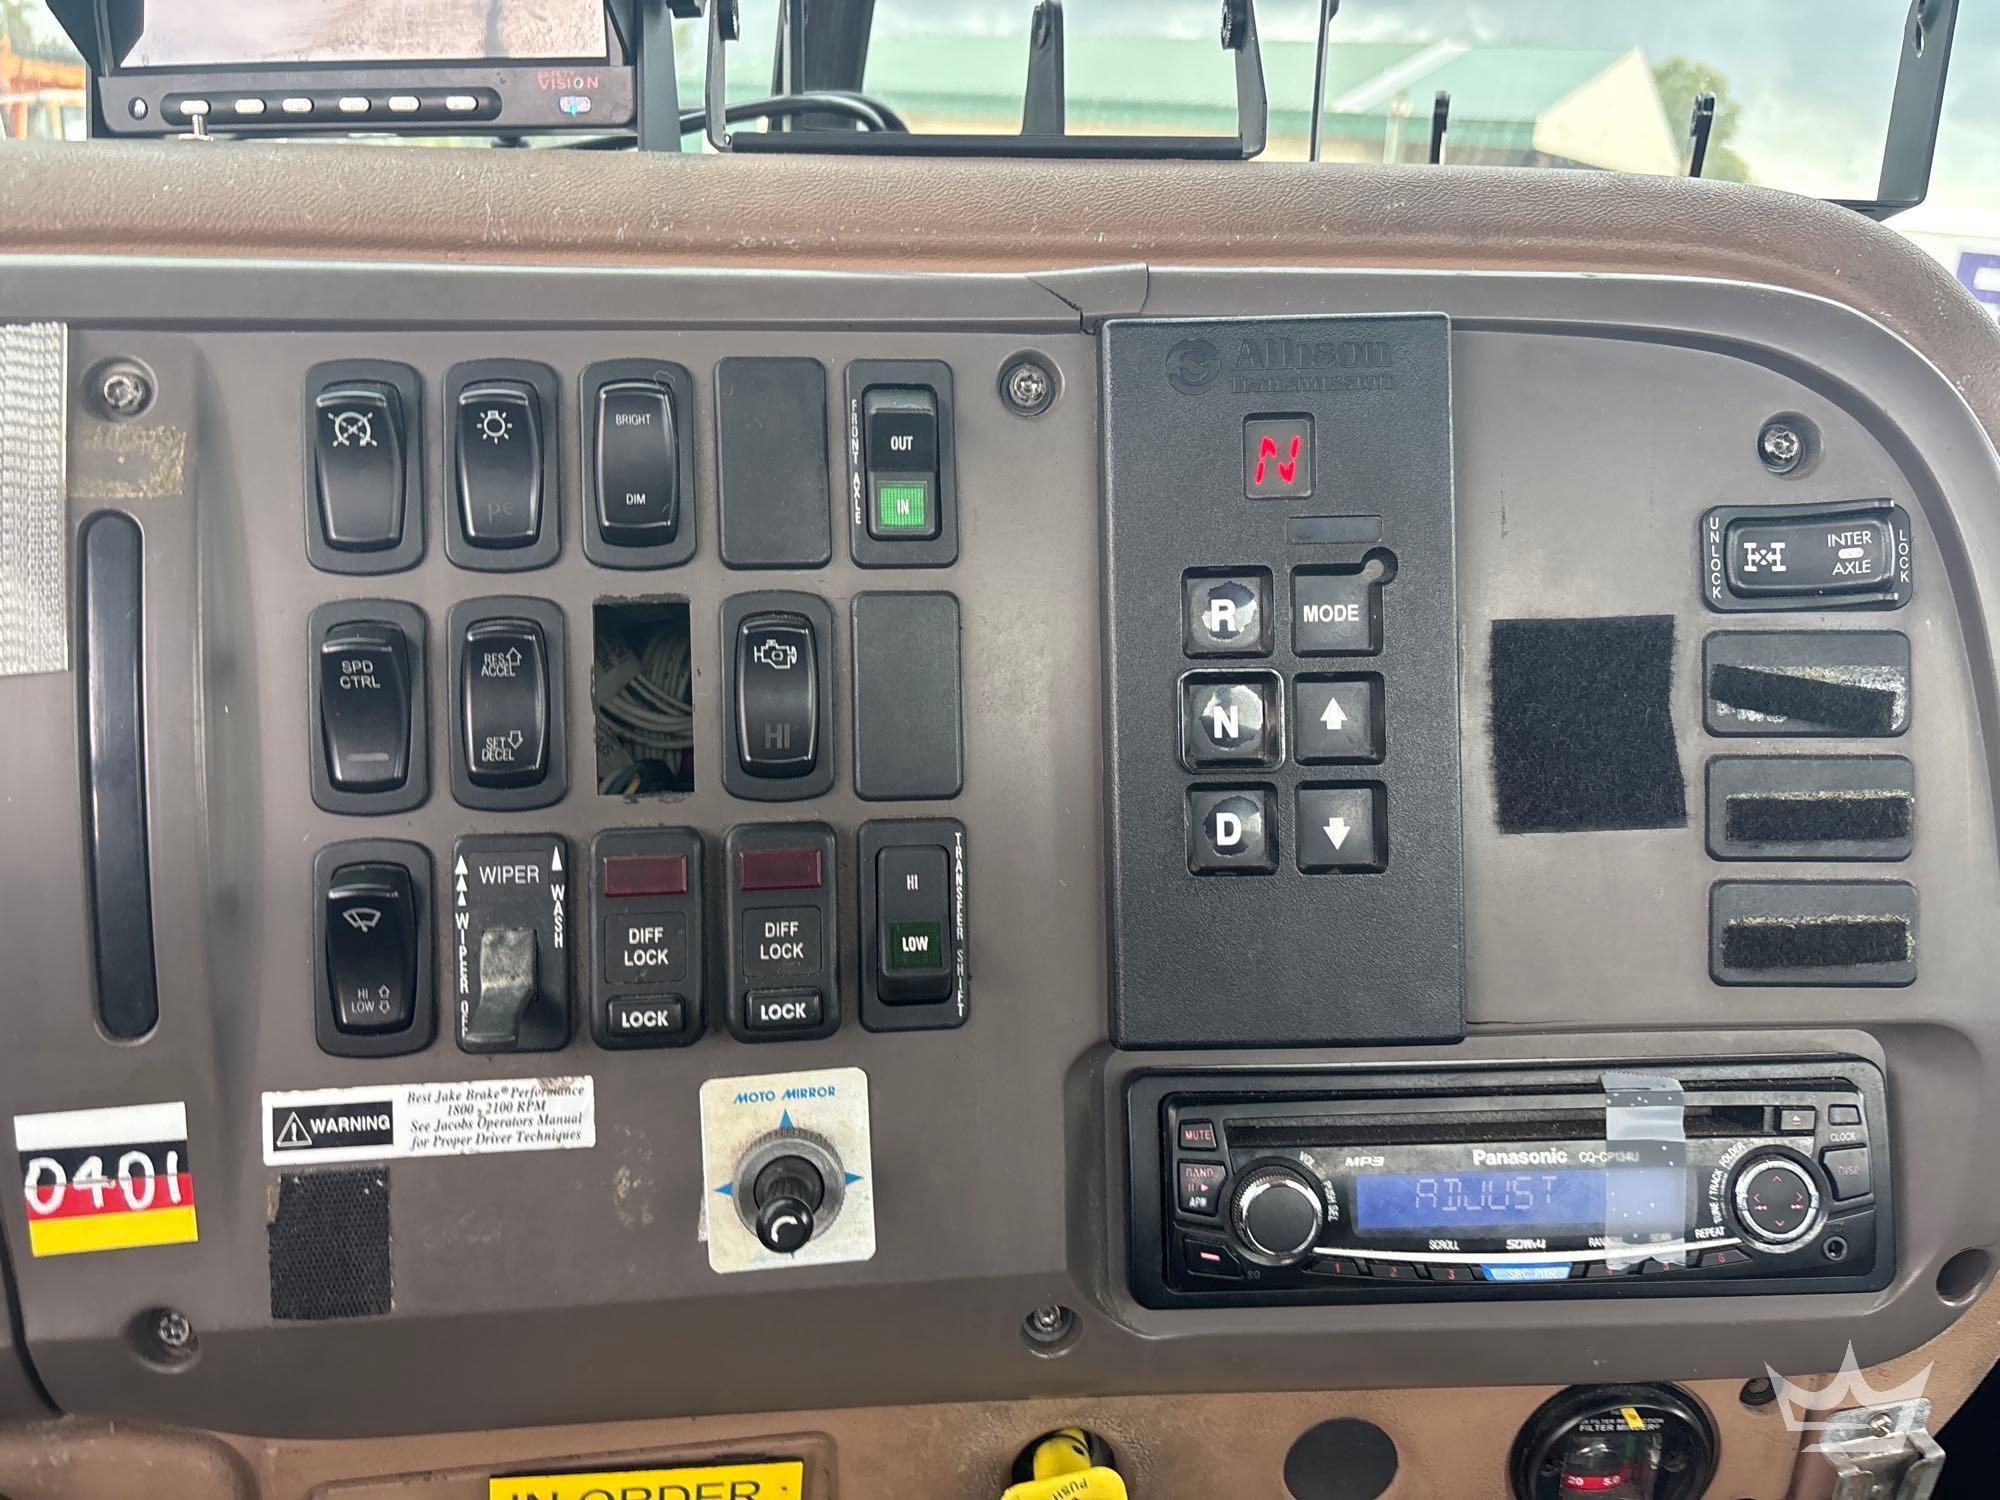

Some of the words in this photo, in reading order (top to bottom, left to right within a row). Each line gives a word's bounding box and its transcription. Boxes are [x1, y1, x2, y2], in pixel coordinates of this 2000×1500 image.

[537, 76, 599, 91] VISION
[615, 413, 651, 426] BRIGHT
[851, 399, 860, 464] FRONT
[891, 436, 914, 451] OUT
[1255, 435, 1300, 485] N
[626, 494, 646, 505] DIM
[853, 472, 862, 525] AXLE
[896, 500, 910, 515] IN
[1827, 530, 1873, 548] INTER
[1709, 517, 1722, 599] UNLOCK
[1898, 529, 1909, 583] LOCK
[1832, 560, 1872, 576] AXLE
[1210, 598, 1237, 632] R
[1303, 604, 1360, 623] MODE
[342, 661, 373, 674] SPD
[481, 664, 517, 678] ACCEL
[340, 676, 381, 690] CTRL
[1213, 706, 1239, 738] N
[486, 736, 507, 750] SET
[765, 723, 791, 749] HI
[481, 748, 515, 762] DECEL
[1215, 812, 1242, 846] D
[479, 865, 540, 885] WIPER
[906, 874, 919, 890] HI
[954, 832, 964, 941] TRANSFER
[550, 884, 566, 949] WASH
[628, 927, 664, 944] DIFF
[764, 921, 799, 938] DIFF
[759, 942, 804, 960] LOCK
[902, 935, 929, 952] LOW
[455, 912, 470, 994] WIPER
[623, 948, 670, 966] LOCK
[956, 949, 964, 1017] SHIFT
[357, 987, 369, 999] HI
[351, 1001, 375, 1014] LOW
[760, 1002, 807, 1021] LOCK
[621, 1010, 669, 1028] LOCK
[408, 1091, 431, 1104] Best
[434, 1090, 462, 1104] Jake
[733, 1090, 776, 1104] MOTO
[781, 1086, 836, 1100] MIRROR
[447, 1103, 474, 1116] 1800
[485, 1101, 513, 1115] 2100
[517, 1099, 546, 1113] RPM
[310, 1115, 390, 1134] WARNING
[410, 1119, 431, 1133] See
[434, 1115, 473, 1132] Jacobs
[477, 1112, 533, 1131] Operators
[537, 1110, 583, 1126] Manual
[410, 1134, 430, 1151] for
[433, 1131, 473, 1149] Proper
[475, 1129, 513, 1145] Driver
[517, 1126, 582, 1143] Techniques
[1184, 1129, 1211, 1141] MUTE
[1830, 1132, 1856, 1142] CLOCK
[1300, 1150, 1315, 1170] VOL
[1345, 1156, 1385, 1167] MP3
[1472, 1148, 1568, 1166] Panasonic
[1719, 1142, 1747, 1168] FOLDER
[1185, 1168, 1214, 1178] BAND
[1709, 1168, 1723, 1196] TRACK
[24, 1151, 181, 1215] 0401
[1415, 1176, 1557, 1211] ADJUST
[1327, 1204, 1339, 1221] SEL
[1709, 1201, 1722, 1224] TUNE
[1695, 1226, 1725, 1239] REPEAT
[1428, 1239, 1460, 1250] SCROLL
[1334, 1263, 1341, 1272] 1
[1390, 1266, 1398, 1276] 2
[1447, 1268, 1456, 1280] 3
[580, 1480, 761, 1500] ORDER
